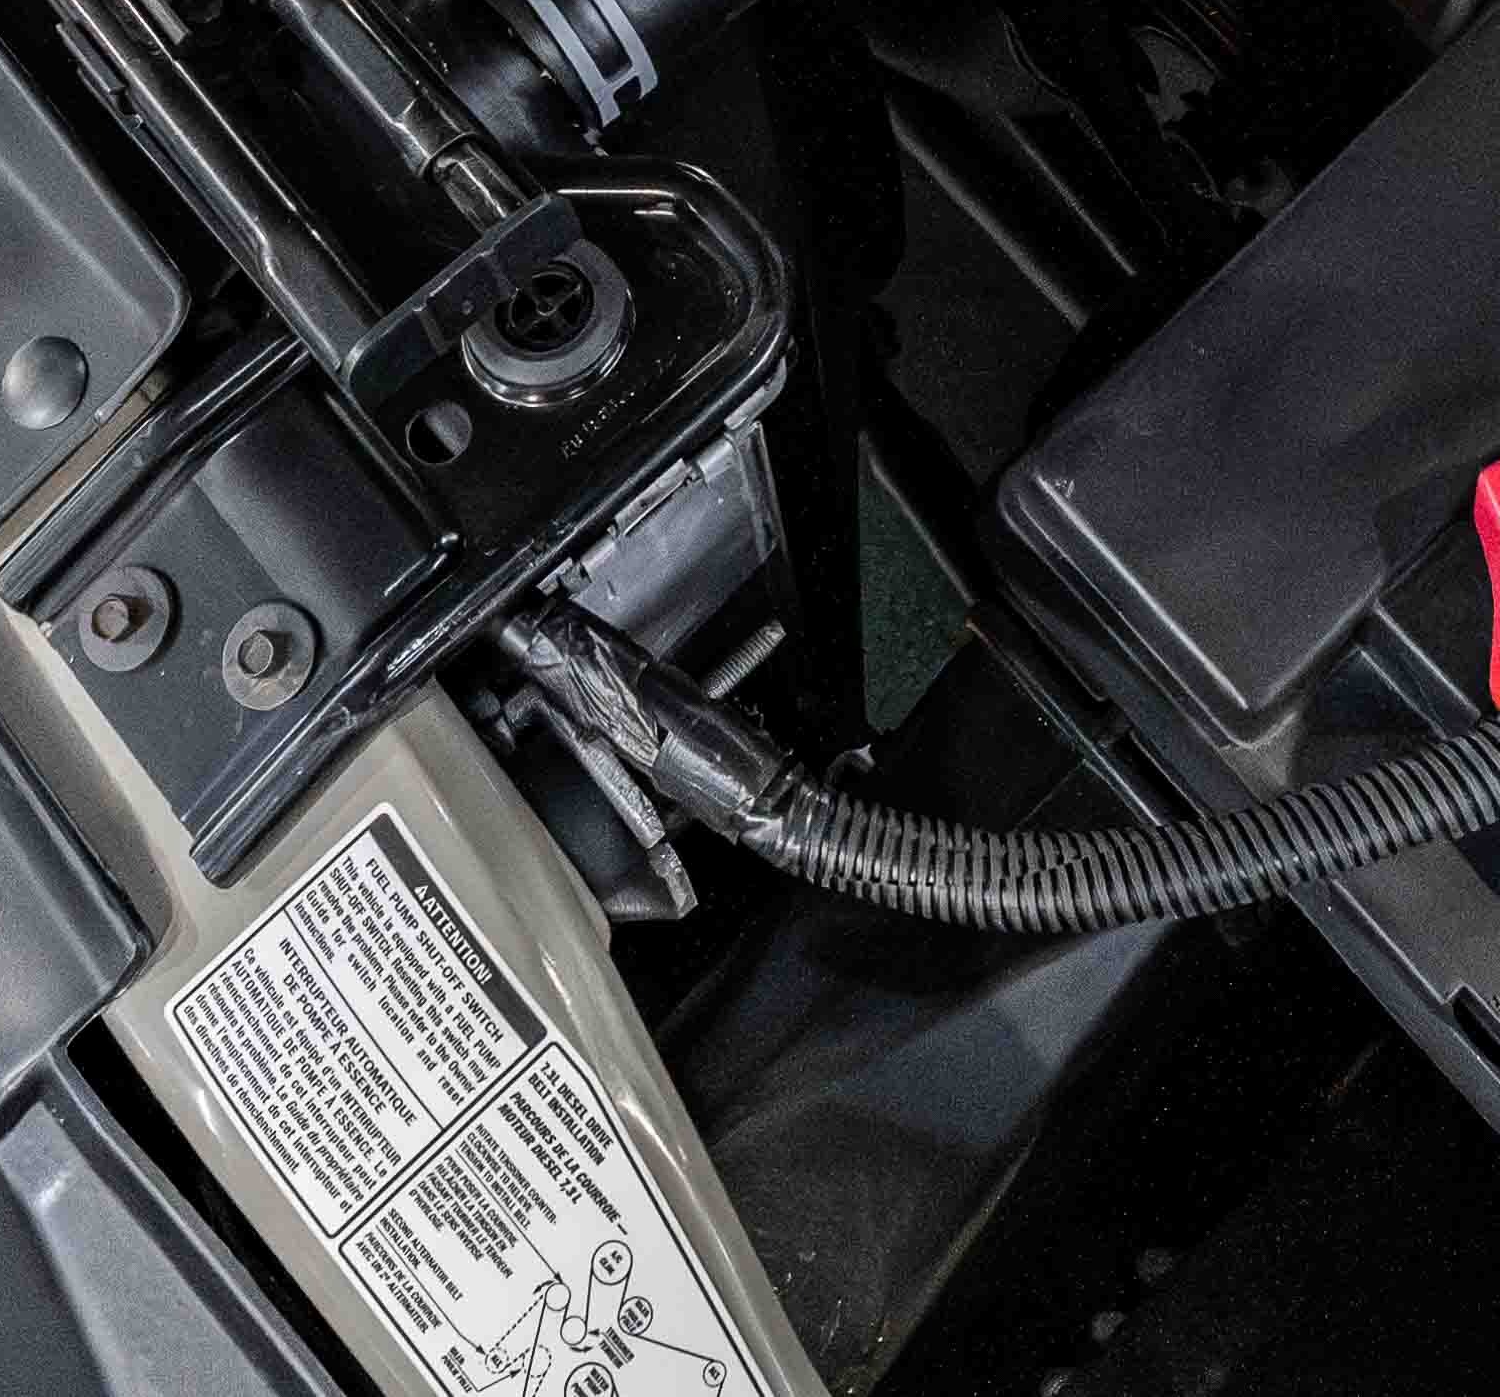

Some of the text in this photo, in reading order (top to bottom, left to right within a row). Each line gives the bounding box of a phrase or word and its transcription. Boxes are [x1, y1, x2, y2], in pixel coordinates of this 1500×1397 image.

[291, 900, 340, 963] instructions.
[304, 889, 465, 1107] Guide for switch location and reset
[315, 878, 476, 1096] resolve the problem. Please refer to the Owner
[327, 866, 489, 1086] SHUT-OFF SWITCH. Resetting this switch may
[340, 856, 501, 1073] This vehicle is equipped with a FUEL PUMP
[364, 856, 503, 1044] FUEL PUMP SHUT-OFF SWITCH
[421, 893, 492, 986] ATTENTION!
[182, 1003, 303, 1175] des directives de réenclenchement.
[193, 992, 353, 1213] donne l'emplacement de cet interrupteur et
[204, 981, 366, 1205] résoudre le problème. Le Guide du propriétaire
[214, 971, 378, 1191] réenclenchement de cet interrupteur peut
[227, 958, 288, 1038] AUTOMATIQUE
[282, 1036, 299, 1056] DE
[294, 1054, 329, 1098] POMPE
[332, 1105, 377, 1163] ESSENCE.
[373, 1159, 389, 1178] Le
[242, 947, 402, 1168] Ce véhicule est équipé d'un INTERRUPTEUR
[275, 937, 417, 1129] INTERRUPTEUR AUTOMATIQUE
[281, 973, 301, 996] DE
[294, 993, 333, 1042] POMPE
[336, 1051, 386, 1116] ESSENCE
[527, 1072, 605, 1167] BELT INSTALLATION
[539, 1061, 613, 1150] 7.3L DIESEL DRIVE
[497, 1101, 535, 1147] MOTEUR
[530, 1142, 563, 1181] DIESEL
[509, 1089, 557, 1146] PARCOURS
[551, 1141, 568, 1161] DE
[563, 1156, 579, 1175] LA
[575, 1171, 620, 1225] COURROIE
